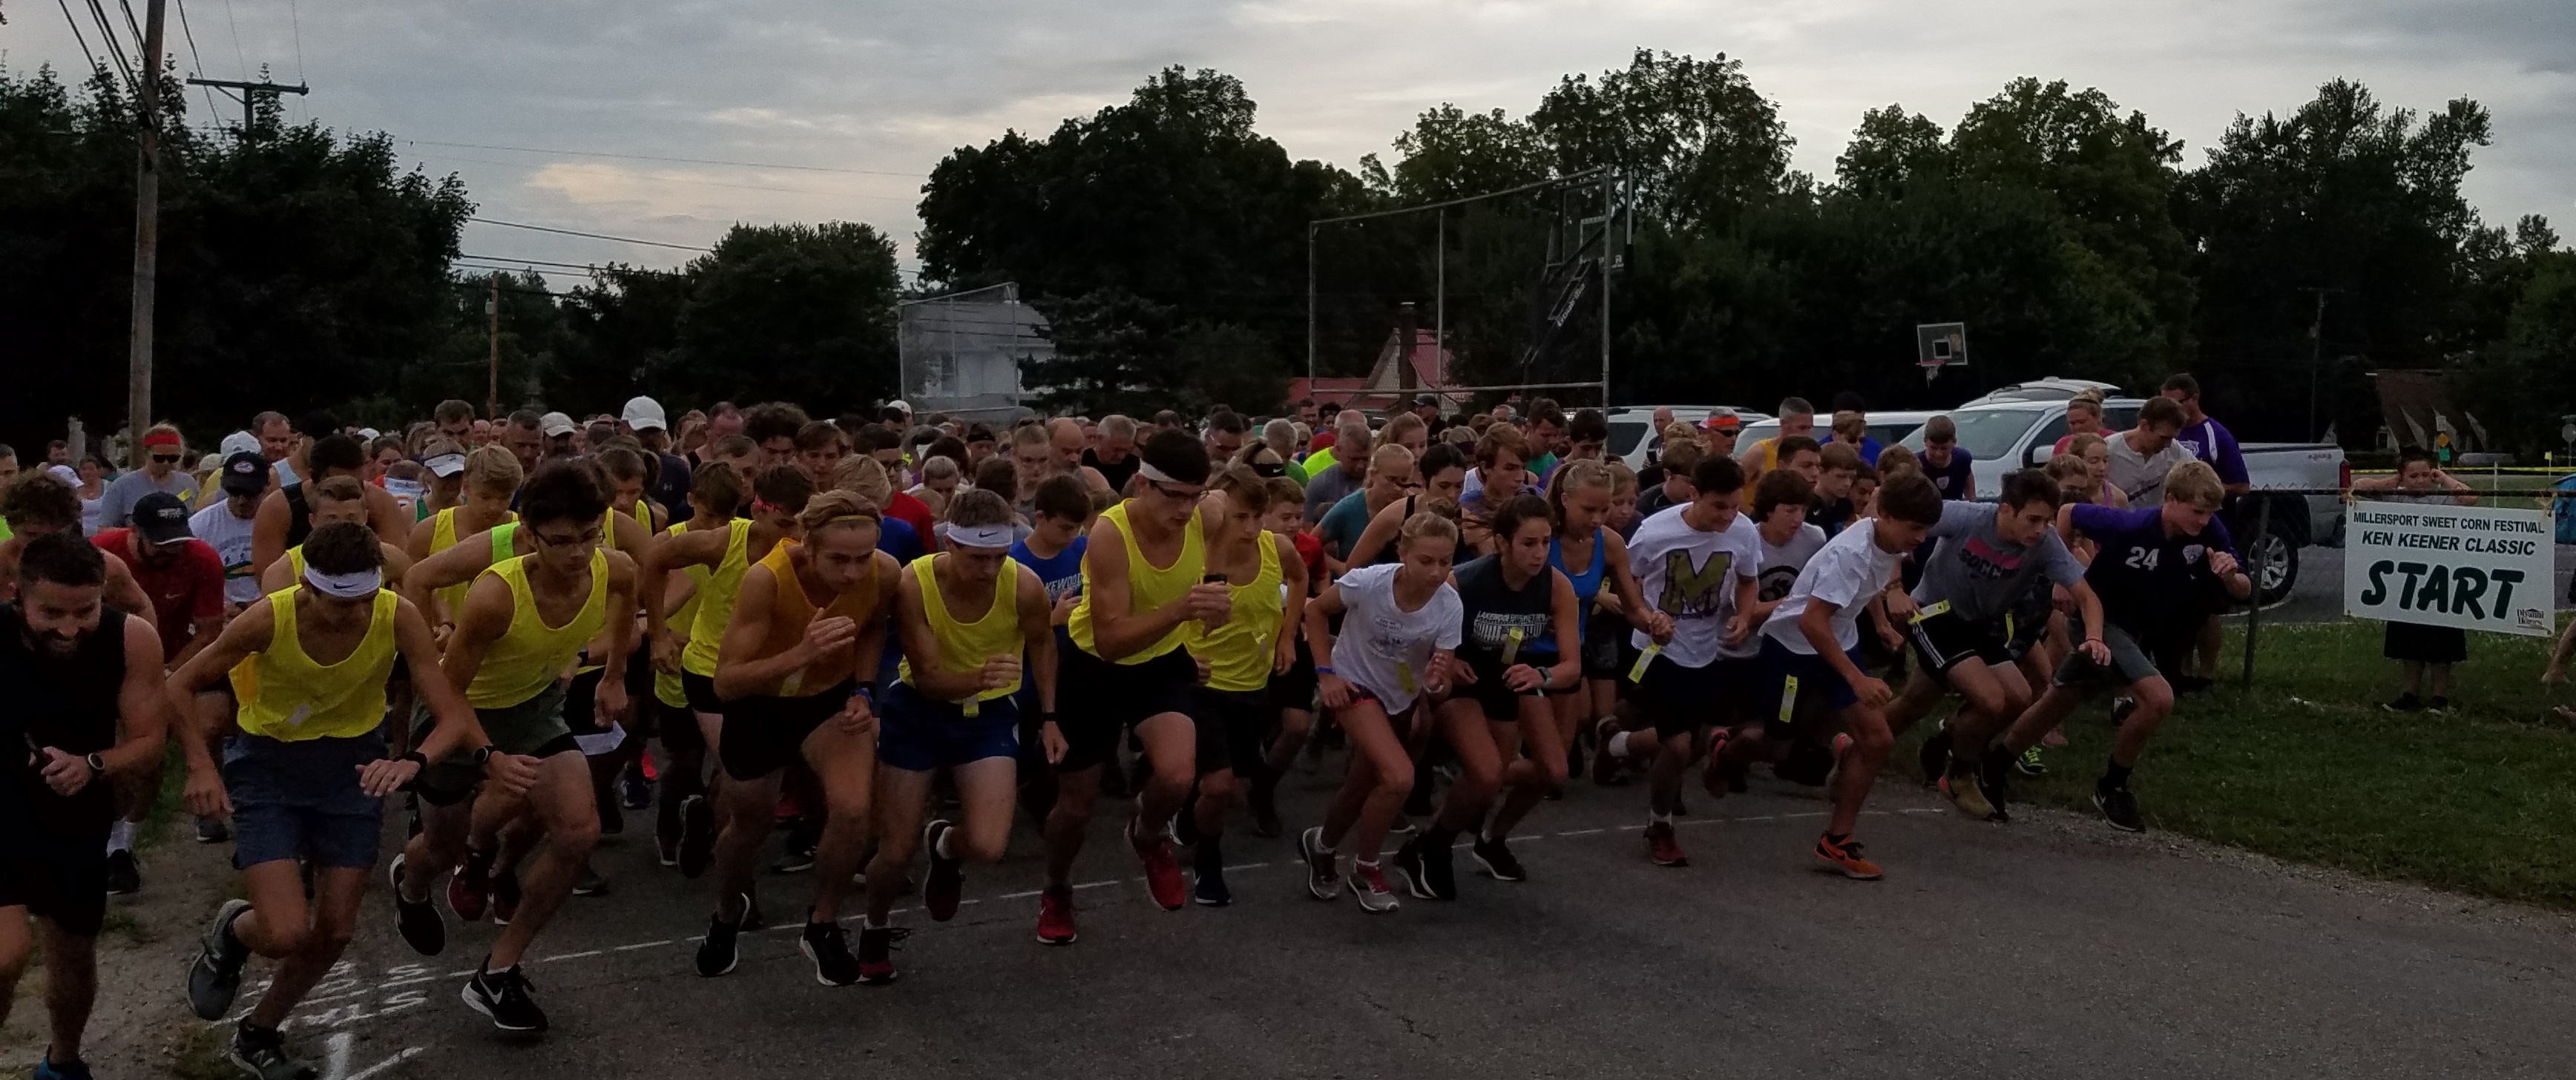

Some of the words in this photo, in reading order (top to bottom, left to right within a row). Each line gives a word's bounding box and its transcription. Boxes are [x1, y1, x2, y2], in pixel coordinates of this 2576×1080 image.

[2353, 512, 2419, 527] MILLERSPORT
[2422, 516, 2457, 529] SWEET
[2461, 518, 2491, 531] CORN
[2494, 520, 2545, 534] FESTIVAL
[2362, 530, 2393, 546] KEN
[2398, 533, 2460, 551] KEENER
[2465, 538, 2536, 556] CLASSIC
[2125, 546, 2160, 571] 24
[1657, 548, 1733, 617] M
[2361, 560, 2525, 620] START
